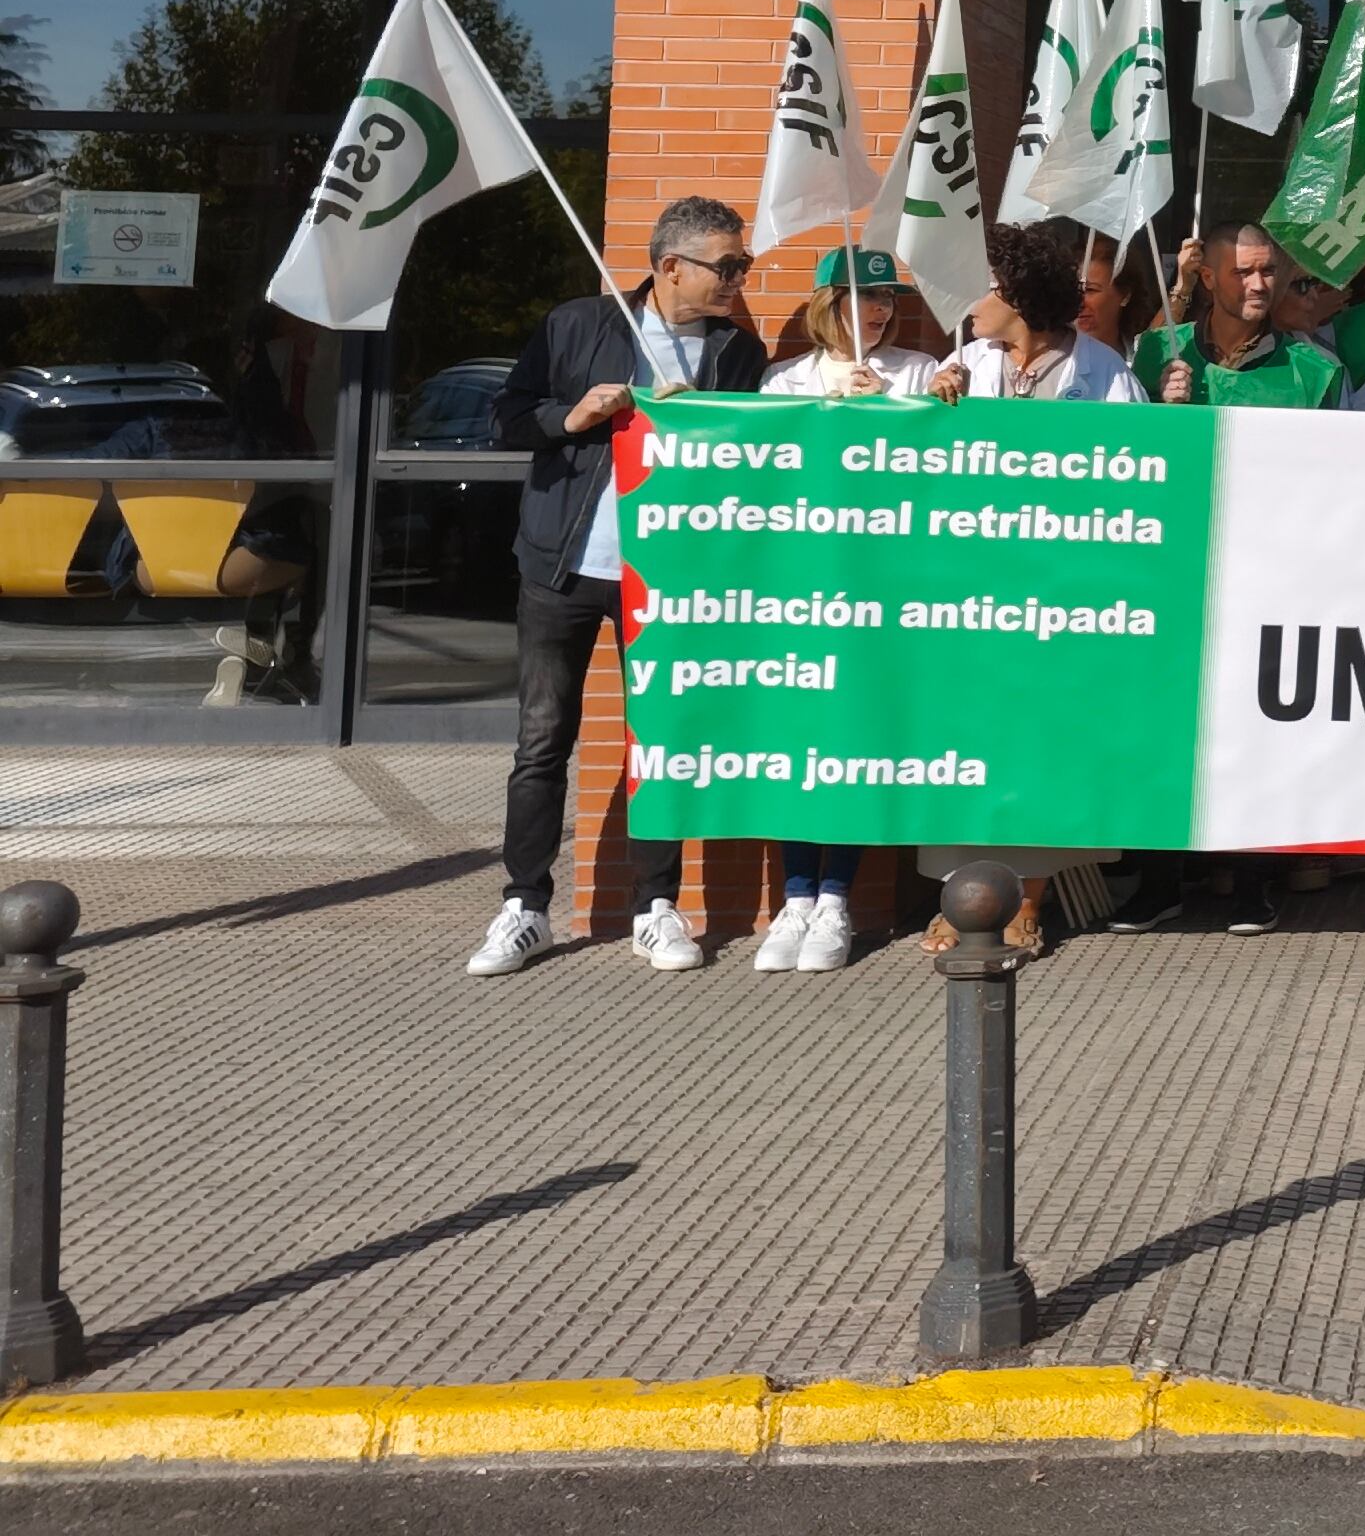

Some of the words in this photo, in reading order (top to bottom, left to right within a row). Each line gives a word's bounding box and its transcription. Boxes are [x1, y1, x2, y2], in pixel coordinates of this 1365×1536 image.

[641, 433, 803, 470] Nueva
[840, 438, 1167, 484] clasificación
[636, 497, 911, 539] profesional
[928, 504, 1163, 546] retribuida
[632, 588, 883, 628] Jubilación
[899, 595, 1156, 642] anticipada
[630, 658, 657, 695] y
[670, 654, 837, 696] parcial
[630, 744, 791, 789] Mejora
[801, 750, 987, 791] jornada
